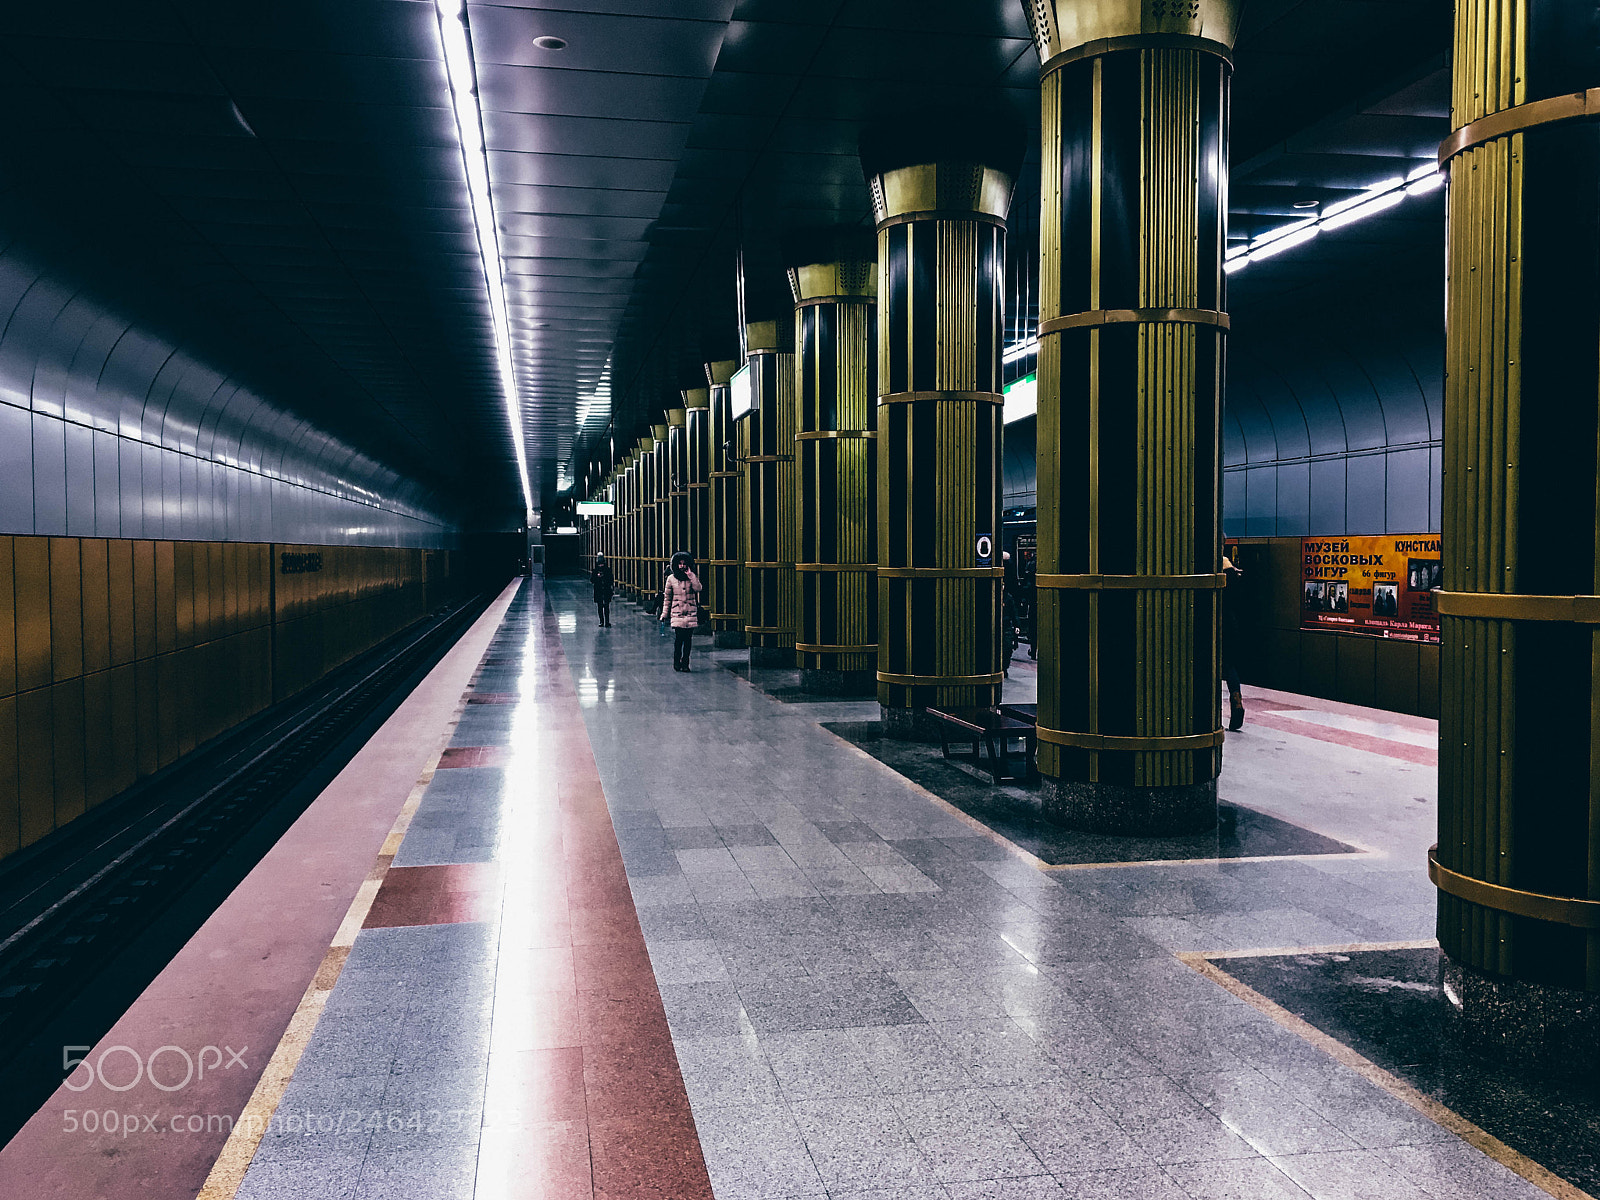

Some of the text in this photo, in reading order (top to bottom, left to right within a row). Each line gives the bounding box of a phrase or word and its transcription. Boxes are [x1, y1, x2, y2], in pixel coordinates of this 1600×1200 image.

[1304, 539, 1350, 553] МУЗЕЙ
[1304, 554, 1384, 566] ВОСКОВЫХ
[1304, 567, 1348, 578] ФИГУР
[1362, 569, 1396, 580] 66 фигур
